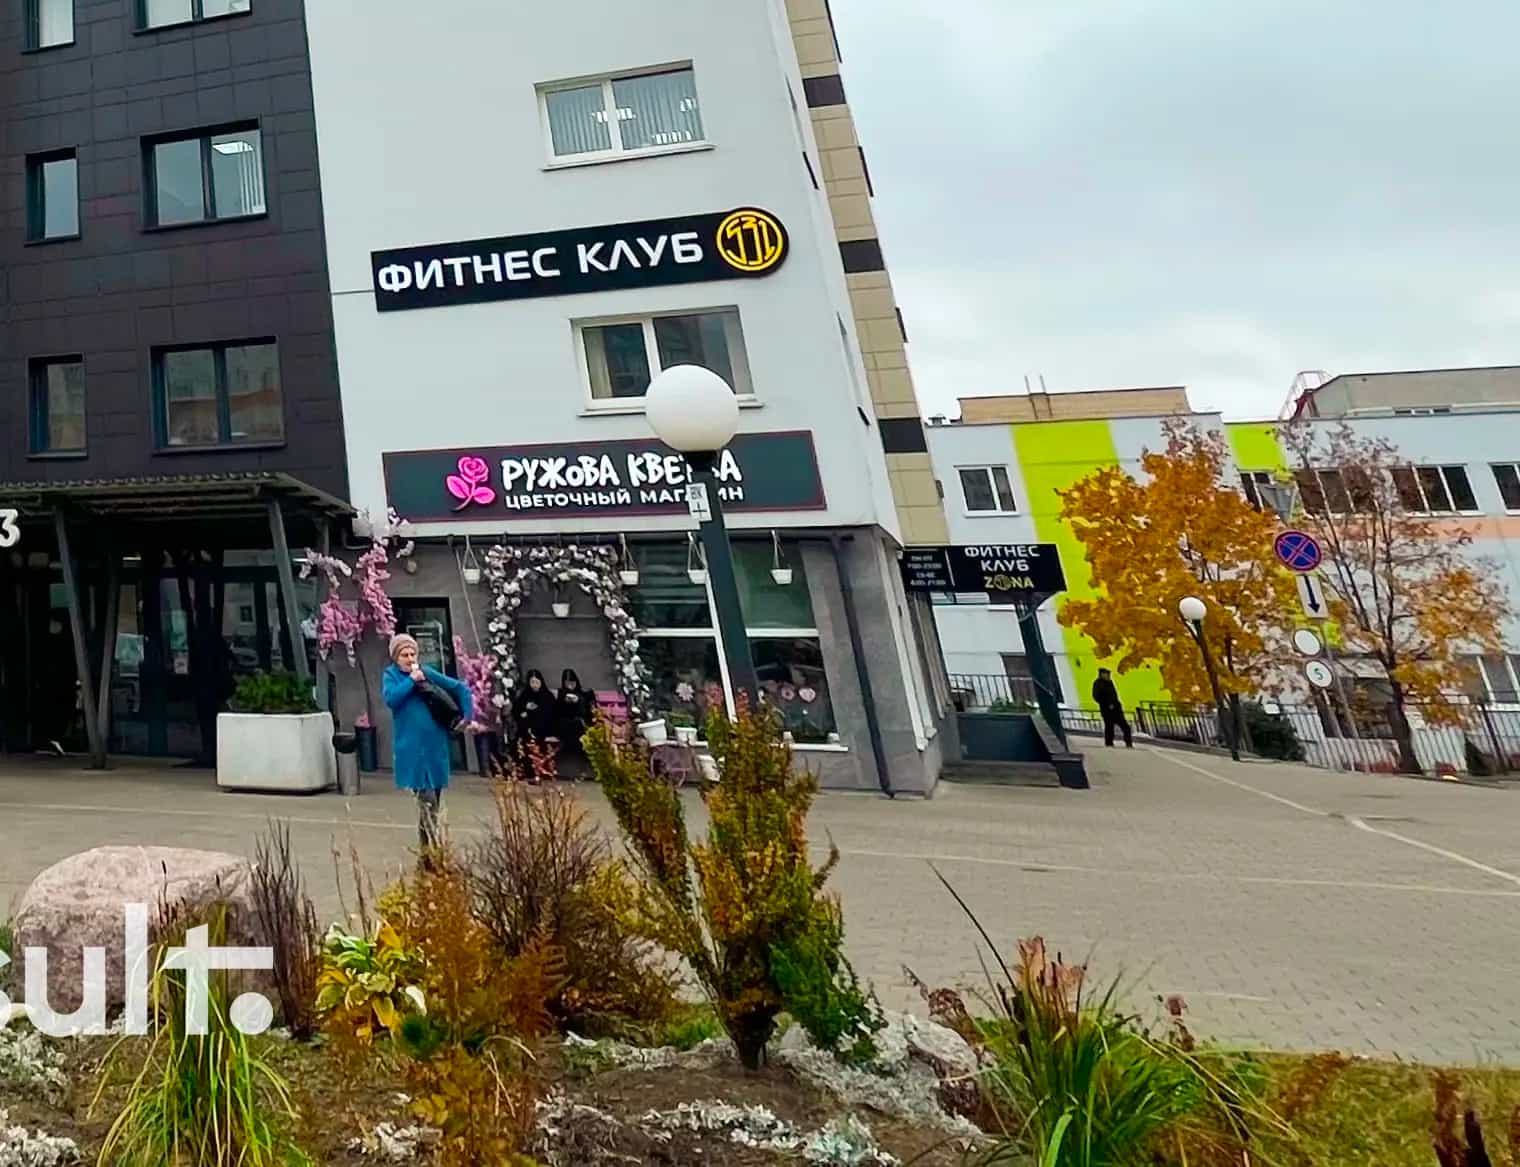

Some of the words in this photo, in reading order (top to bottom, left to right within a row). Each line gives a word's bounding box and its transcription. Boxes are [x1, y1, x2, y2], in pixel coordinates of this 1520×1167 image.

[379, 247, 560, 292] ФИТНЕС
[578, 232, 703, 273] КЛУБ
[627, 449, 743, 487] КВЕА
[506, 489, 631, 510] ЦВЕТОЧНЫЙ
[640, 486, 744, 503] МАГИН
[964, 545, 1041, 558] ФИТНЕС
[981, 559, 1030, 572] КЛУБ
